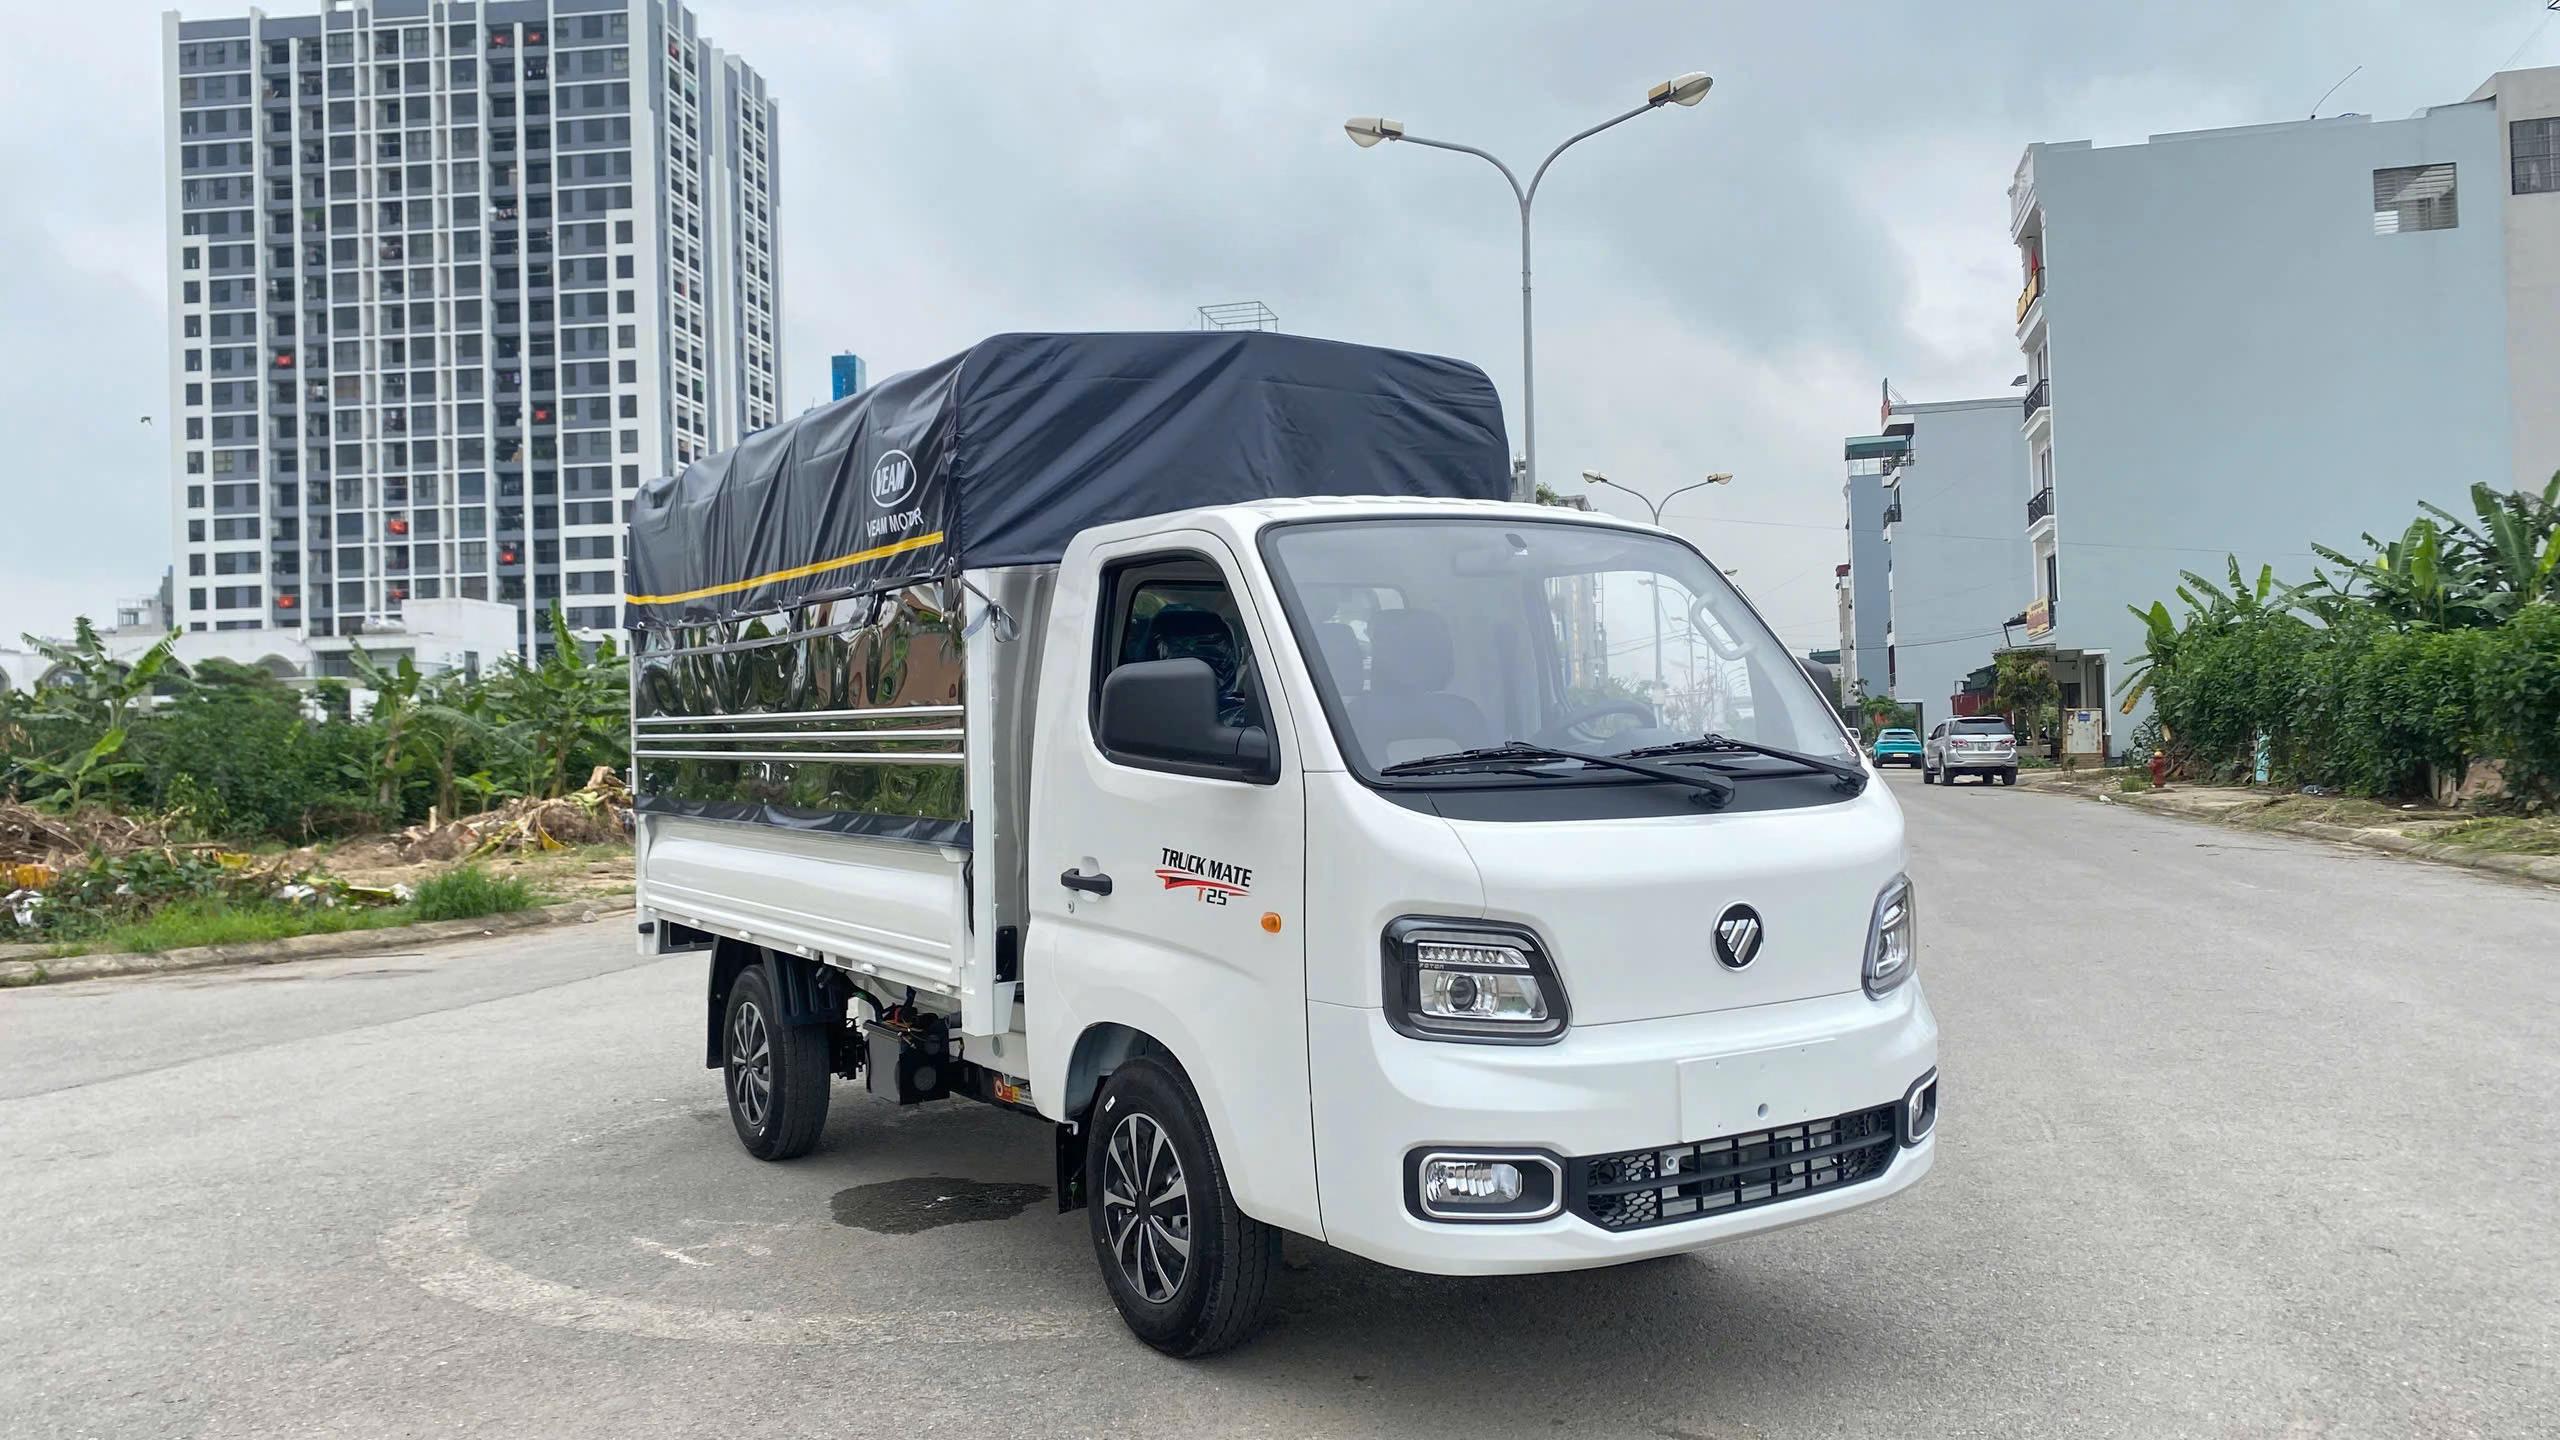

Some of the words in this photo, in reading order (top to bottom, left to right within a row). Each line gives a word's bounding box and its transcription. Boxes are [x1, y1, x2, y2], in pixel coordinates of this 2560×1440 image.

[876, 460, 907, 497] VEAM
[867, 516, 888, 538] VEAM
[1162, 847, 1206, 876] TRUCK
[1207, 861, 1252, 888] MATE
